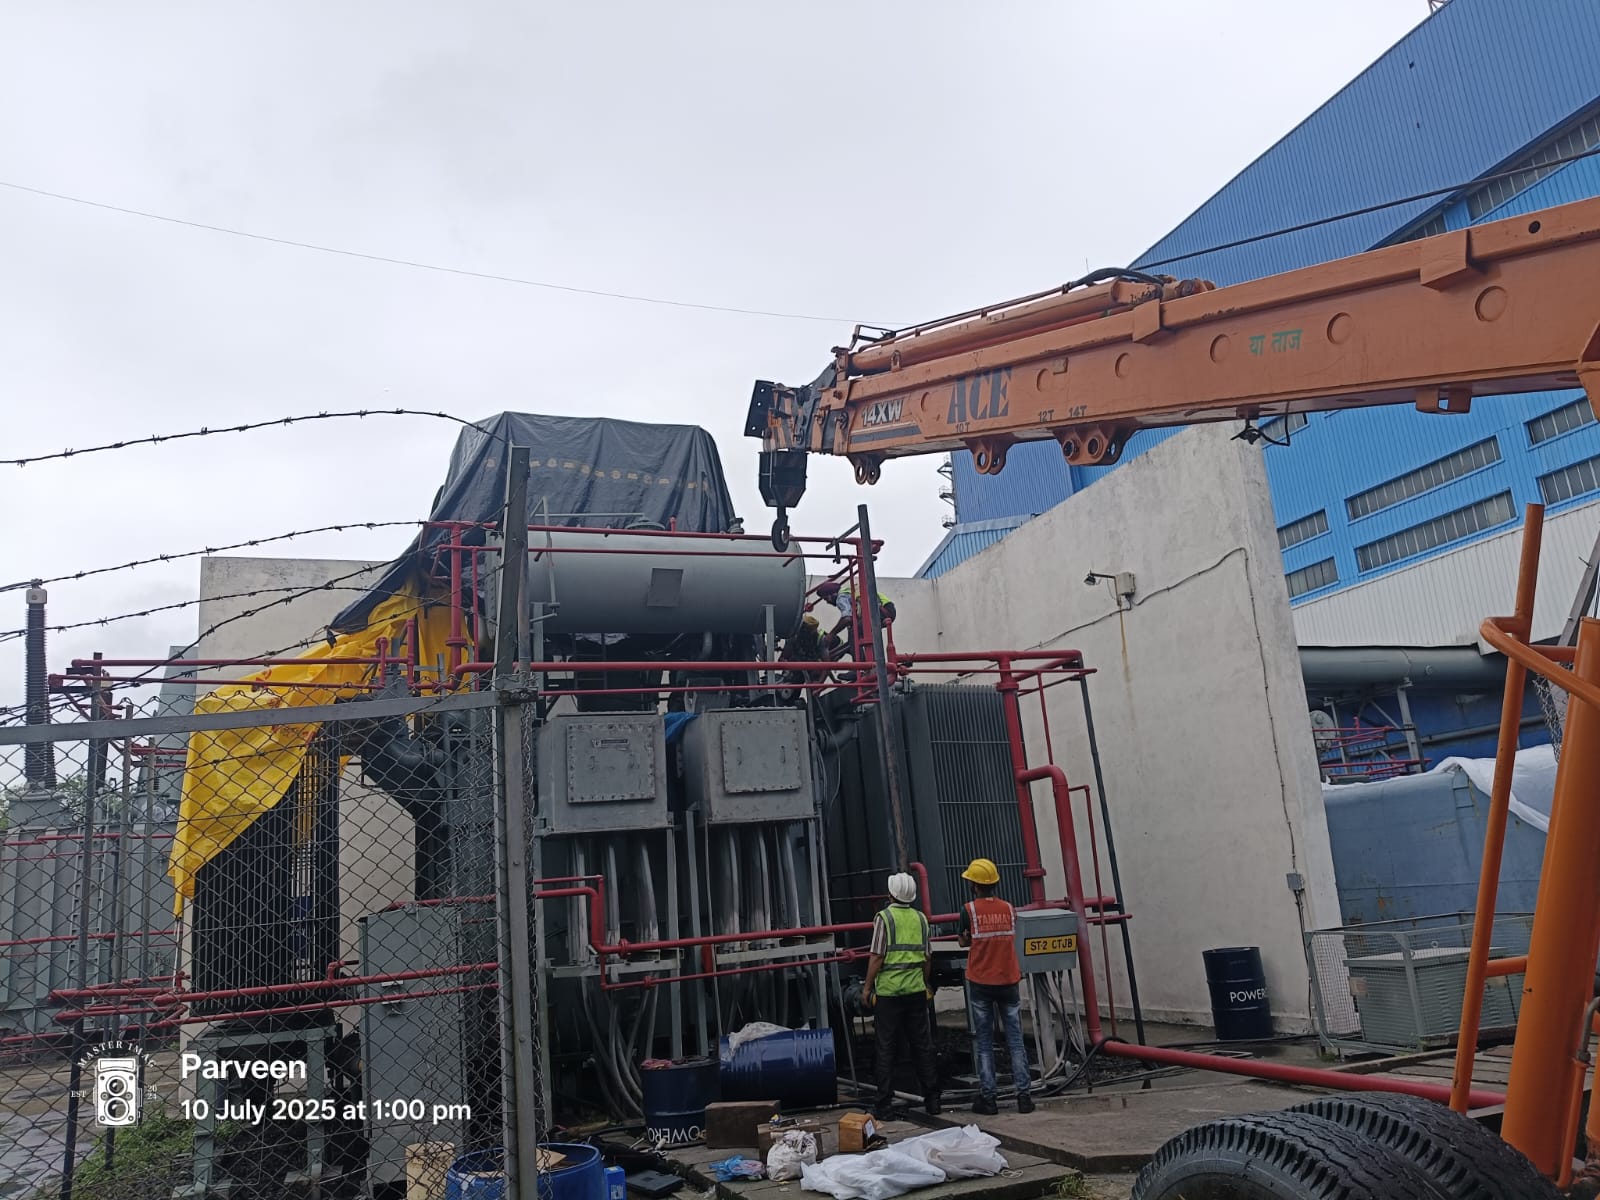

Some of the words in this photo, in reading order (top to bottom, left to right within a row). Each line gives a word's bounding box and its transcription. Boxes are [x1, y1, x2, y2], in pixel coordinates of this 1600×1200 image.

[946, 367, 1012, 424] ACE
[861, 399, 904, 426] 14XW
[1038, 409, 1054, 422] 12T
[1069, 404, 1088, 419] 14T
[1051, 938, 1073, 949] CTJB
